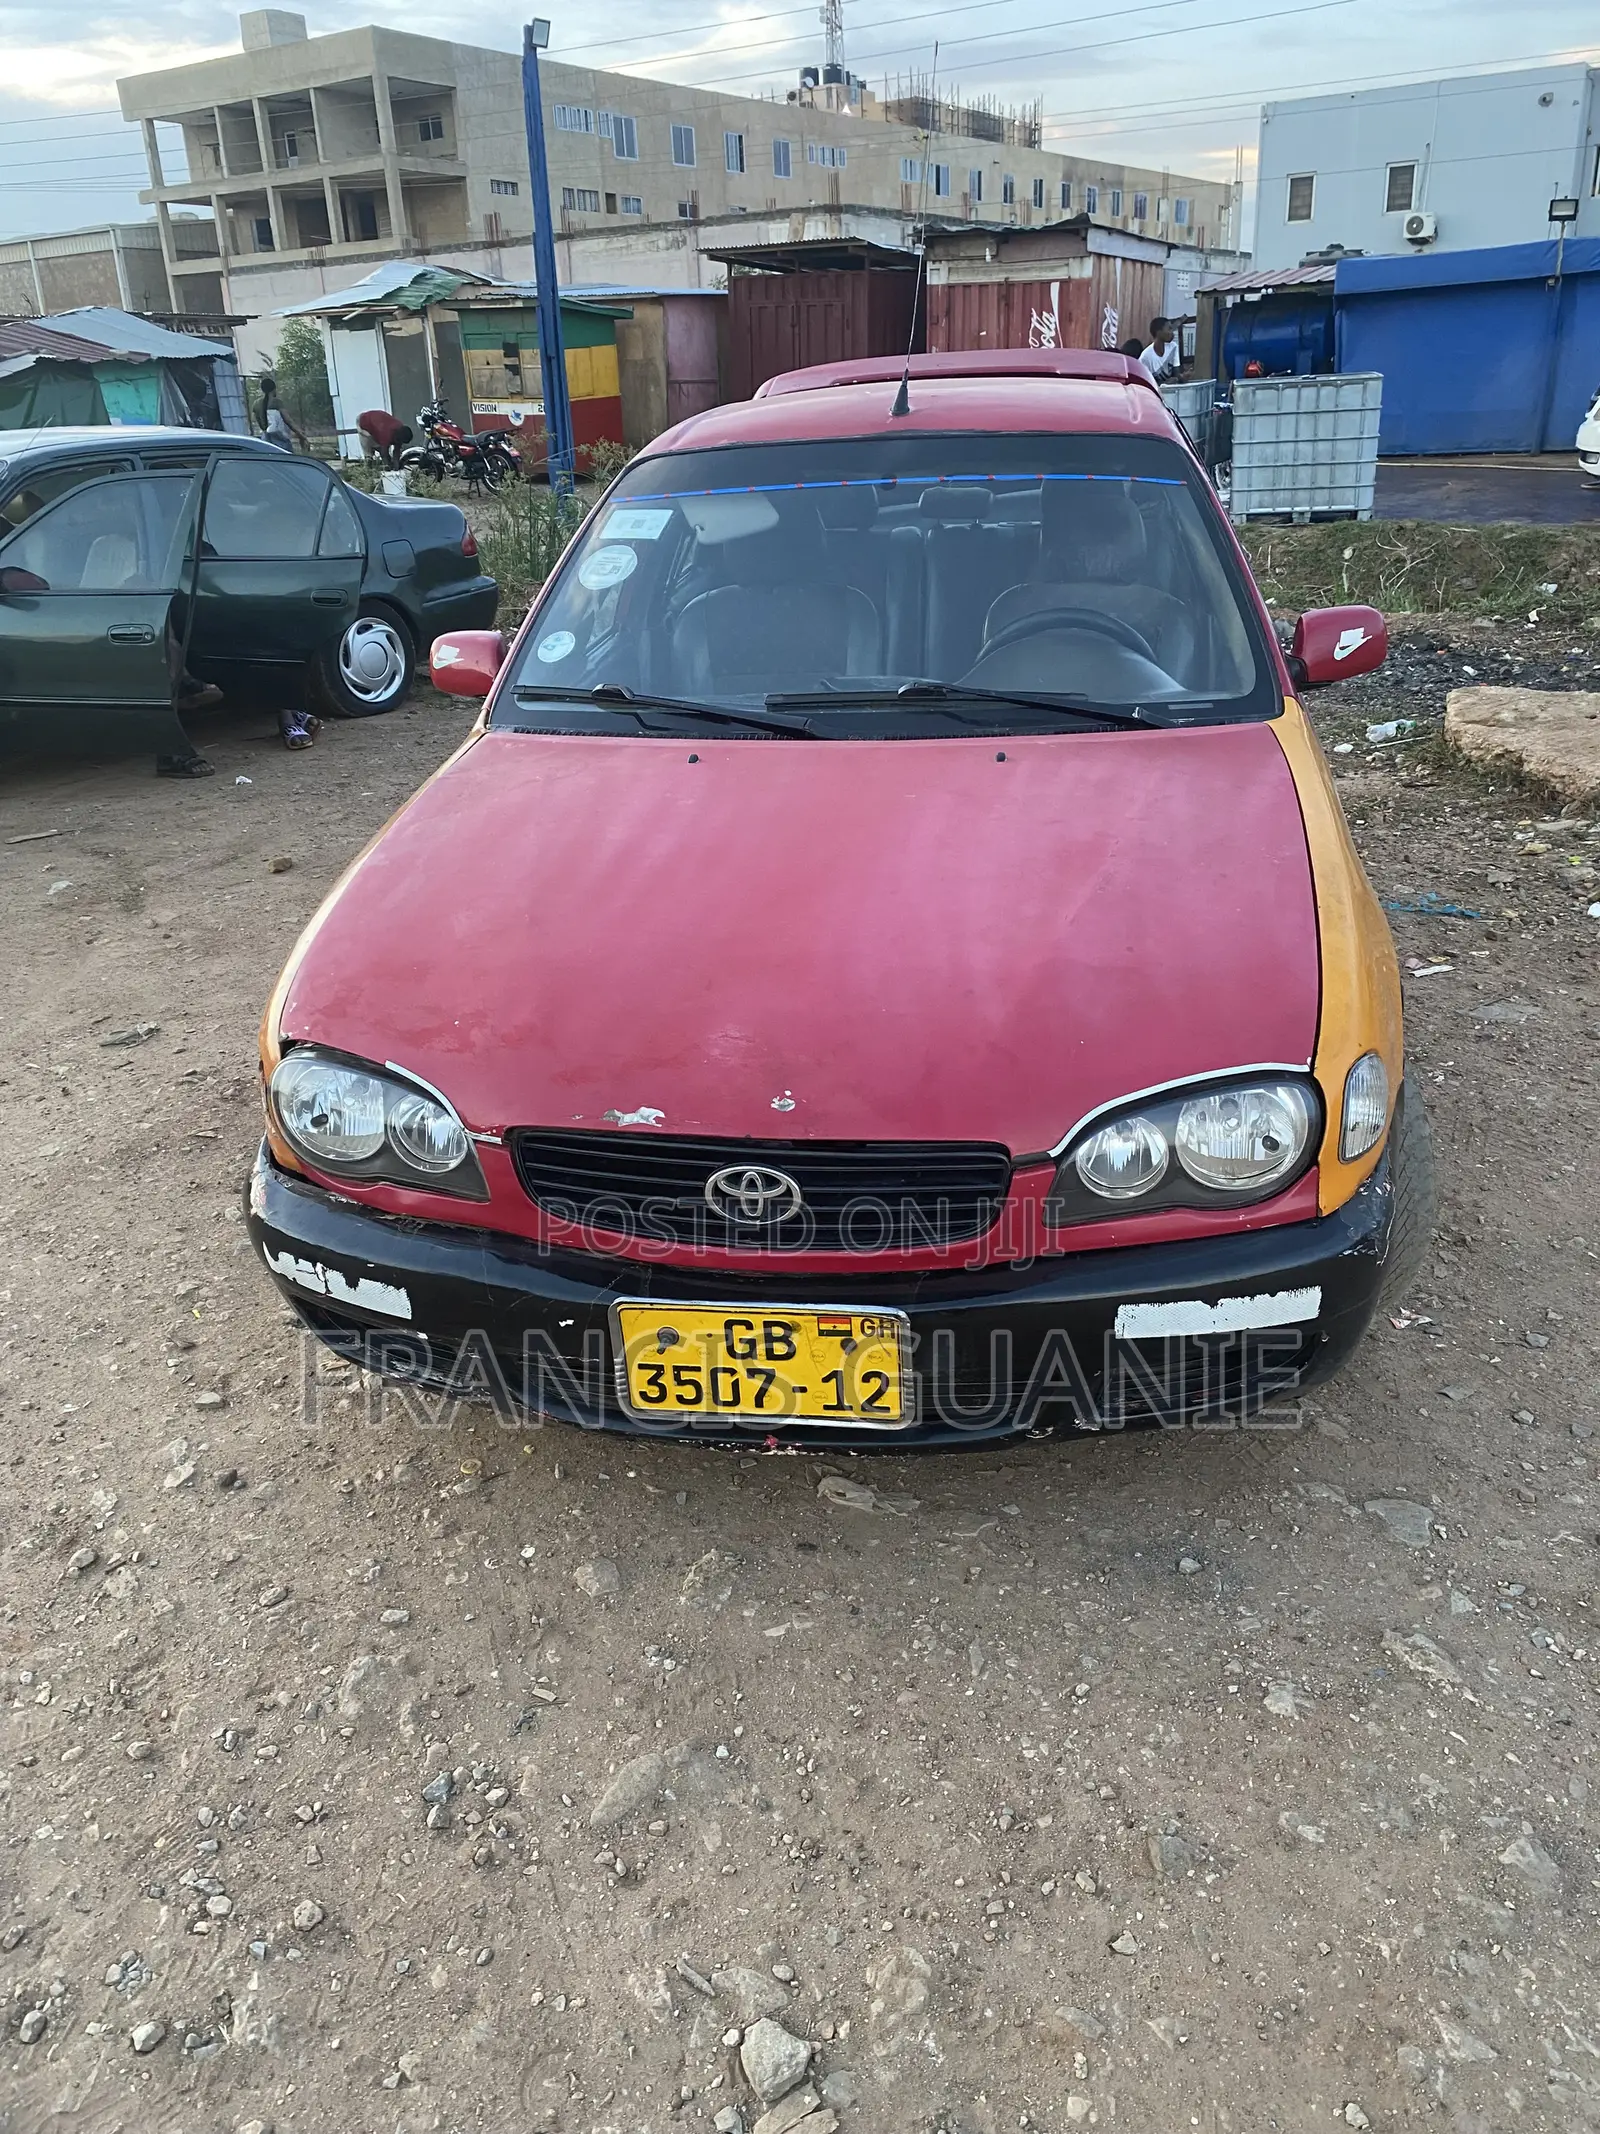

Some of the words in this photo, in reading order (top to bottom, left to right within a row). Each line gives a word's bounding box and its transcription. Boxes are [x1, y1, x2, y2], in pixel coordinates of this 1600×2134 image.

[473, 403, 497, 412] VISION
[860, 1317, 896, 1339] GH
[724, 1318, 796, 1361] GB
